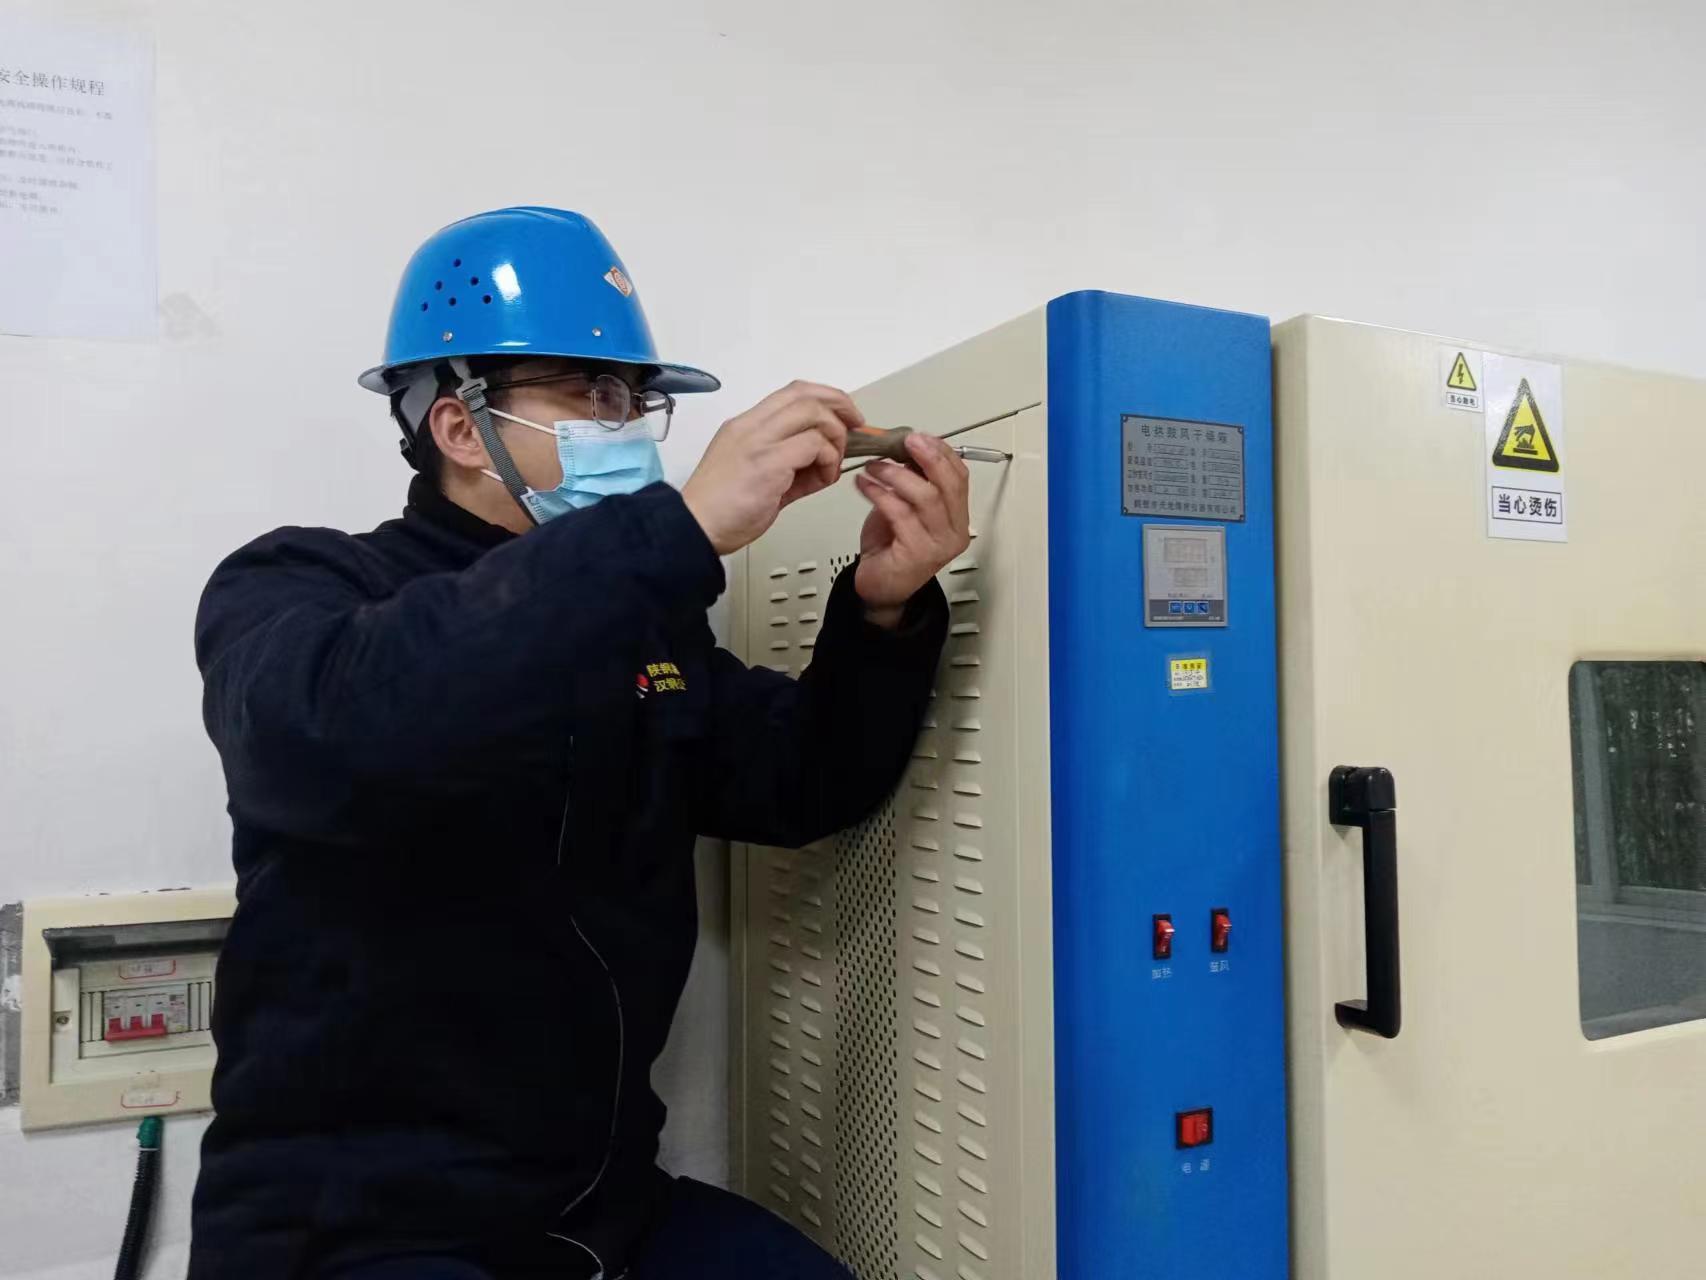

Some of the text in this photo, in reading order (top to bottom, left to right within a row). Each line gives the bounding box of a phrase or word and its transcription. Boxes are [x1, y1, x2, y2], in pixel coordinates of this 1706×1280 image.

[0, 68, 104, 96] 安全操作规程
[1498, 493, 1557, 518] 当心烫伤
